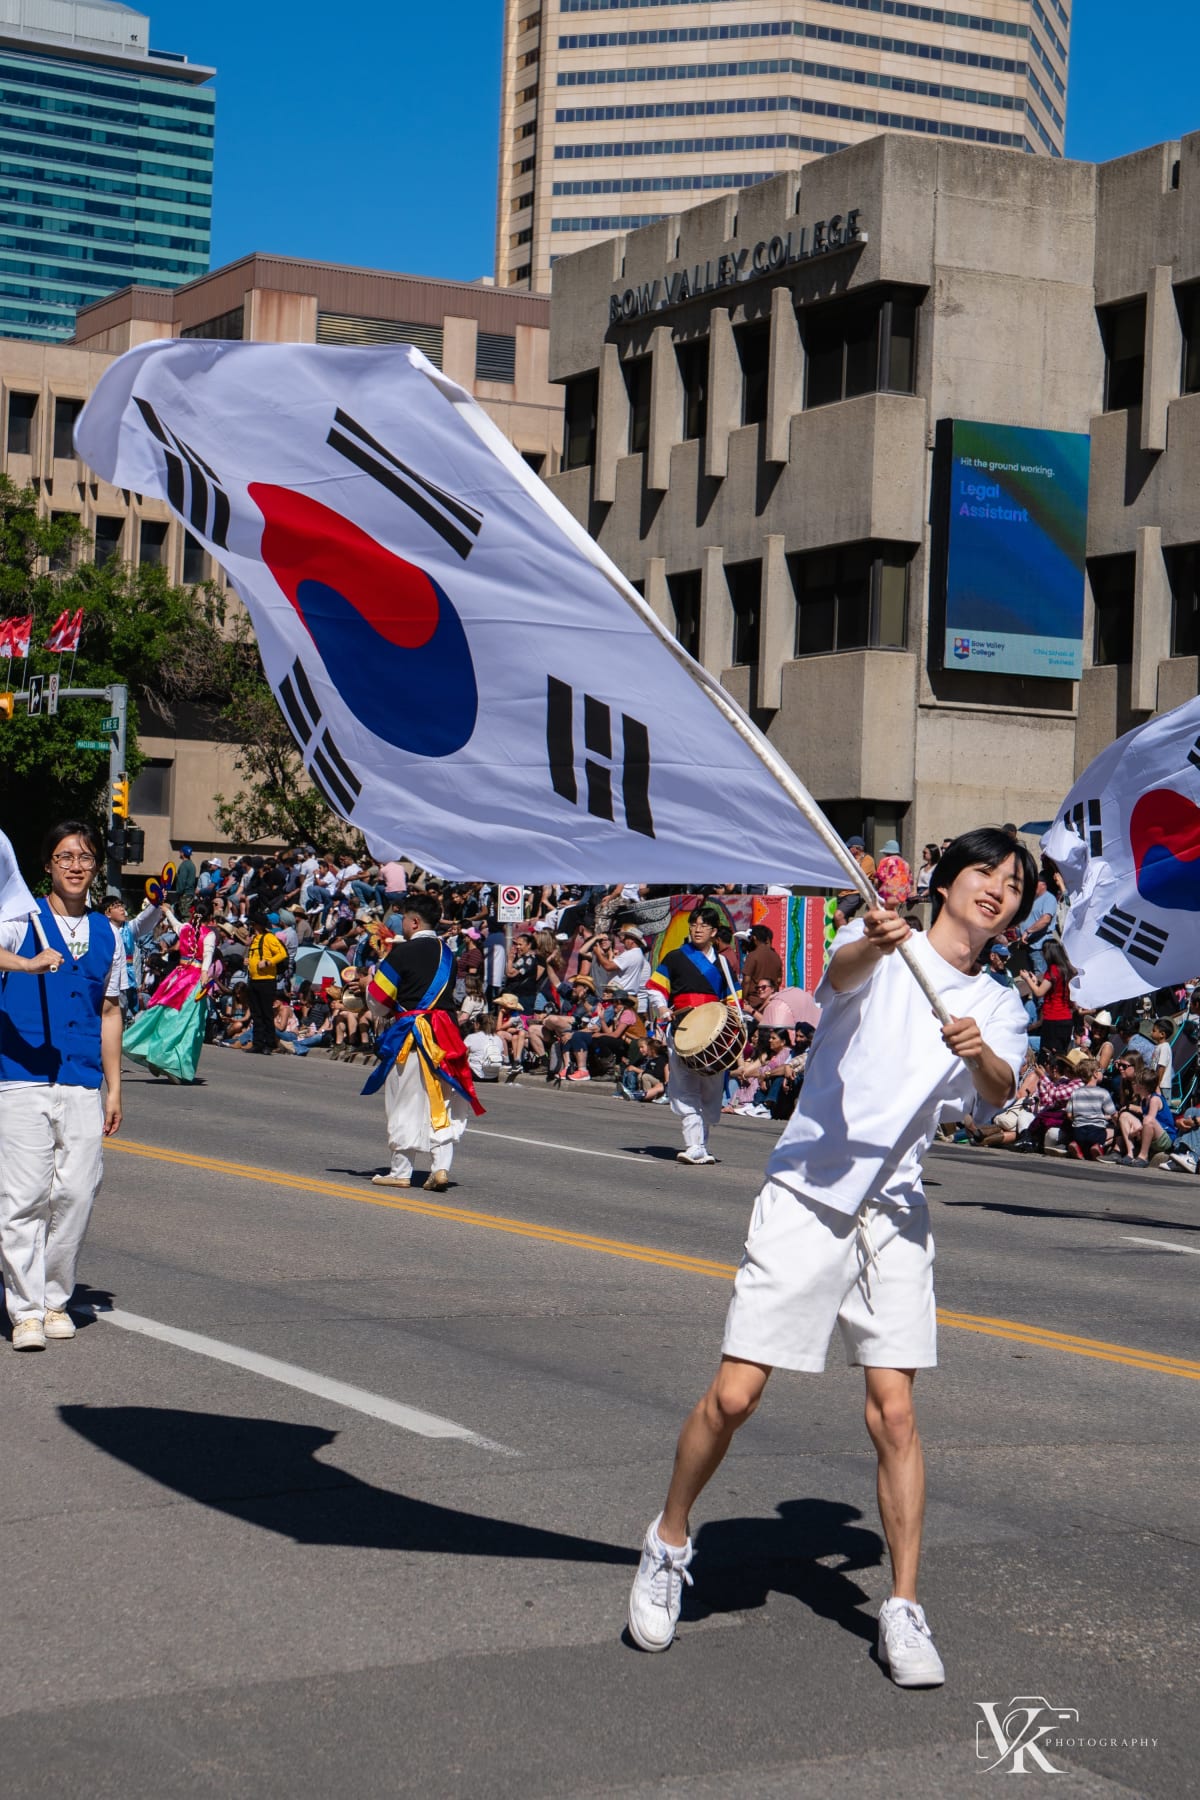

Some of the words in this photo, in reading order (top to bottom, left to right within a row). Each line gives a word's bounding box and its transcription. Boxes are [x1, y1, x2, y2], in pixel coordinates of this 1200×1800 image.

[609, 280, 660, 321] BOW
[664, 249, 748, 305] VALLEY
[752, 208, 862, 276] COLLEGE
[960, 457, 972, 467] Hit
[974, 458, 988, 468] the
[989, 461, 1019, 472] ground
[1020, 464, 1055, 478] working.
[960, 480, 1000, 502] Legal
[960, 502, 1029, 522] Assistant
[971, 640, 986, 649] Bow
[987, 640, 1005, 651] Valley
[971, 648, 996, 658] College
